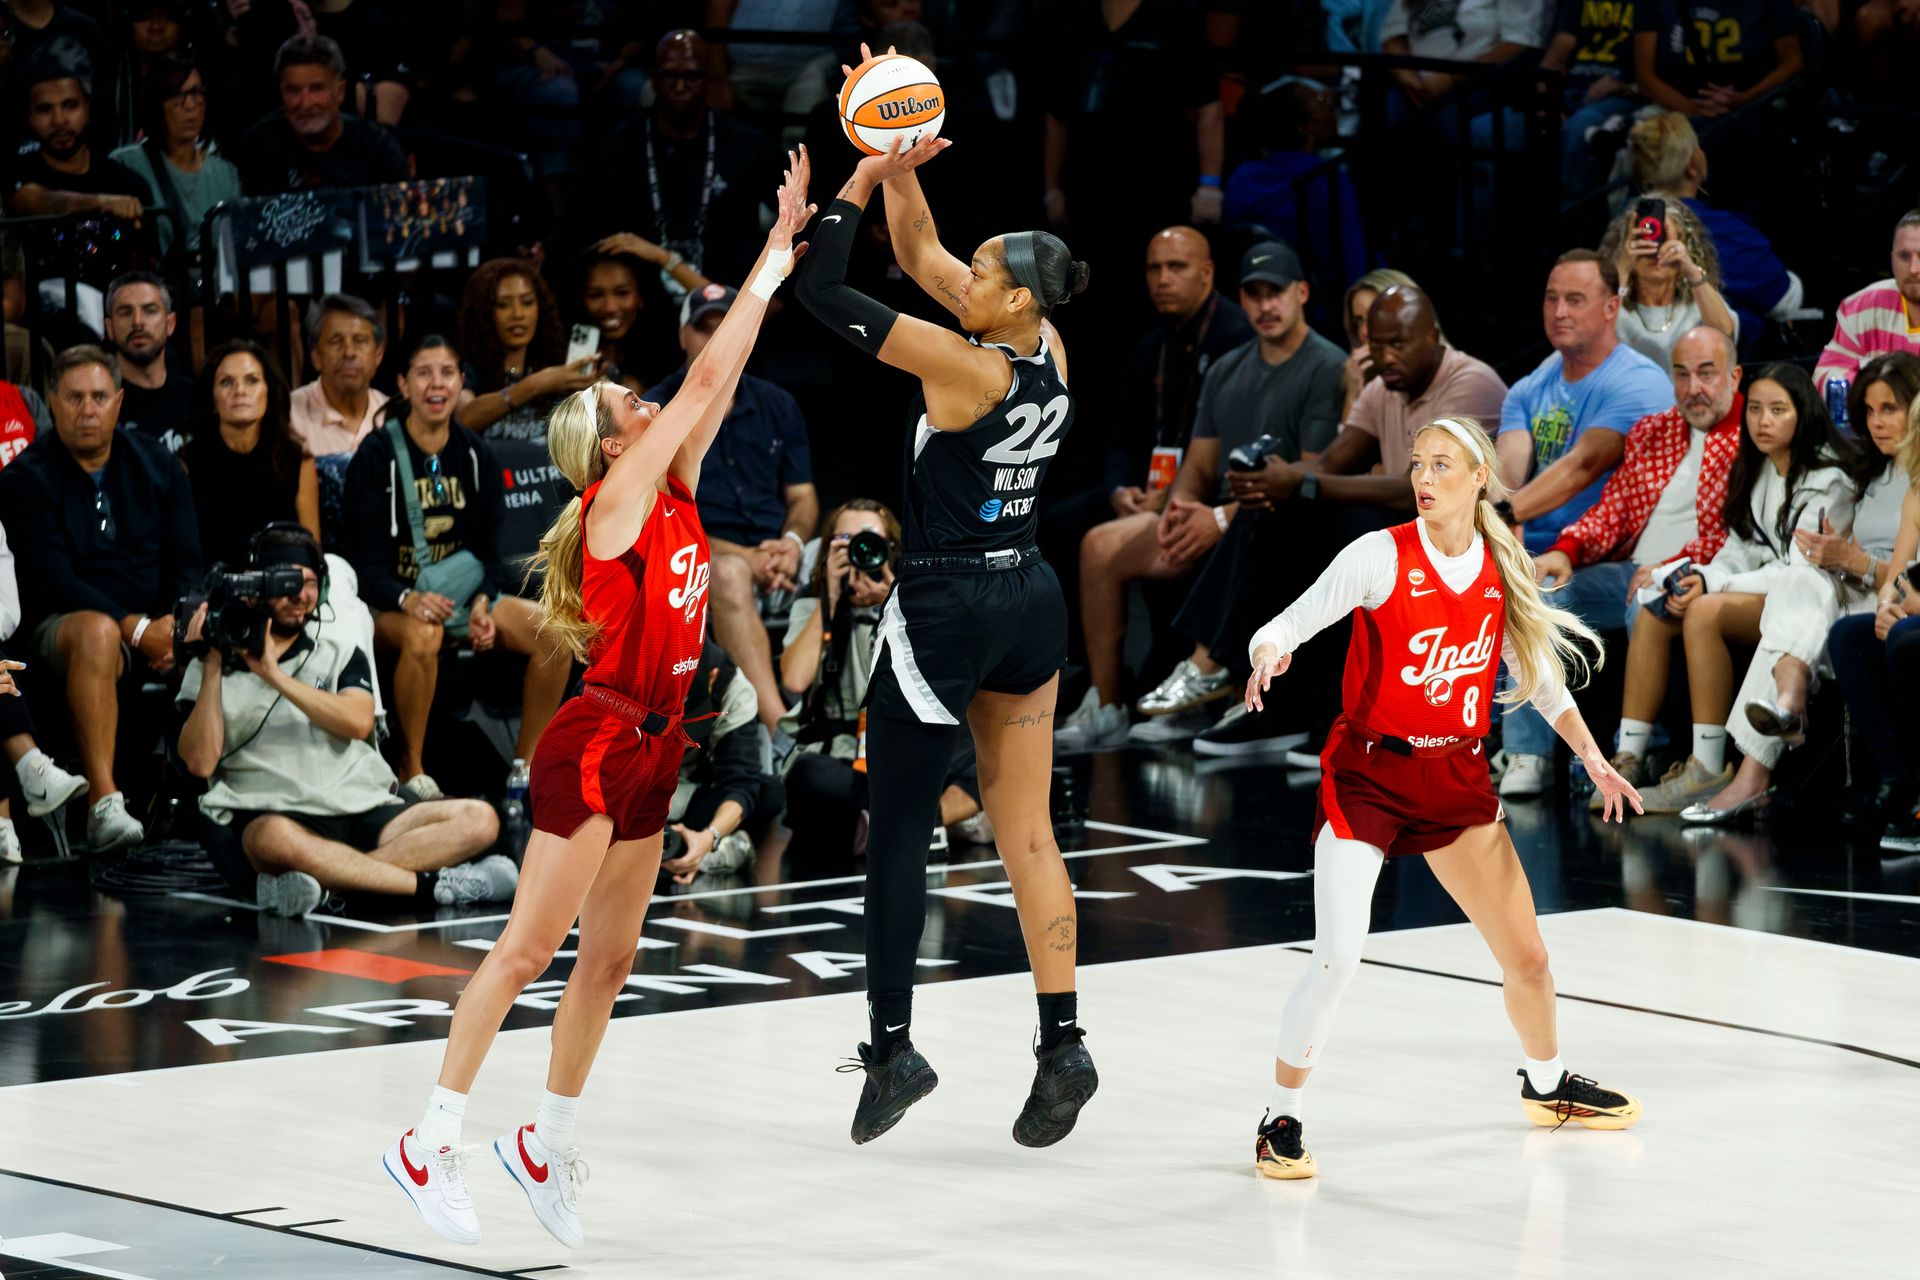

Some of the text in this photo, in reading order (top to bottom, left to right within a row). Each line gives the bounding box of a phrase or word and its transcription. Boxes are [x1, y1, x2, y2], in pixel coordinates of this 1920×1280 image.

[877, 97, 940, 121] Wilson
[982, 395, 1069, 464] 22
[994, 466, 1039, 491] WILSON
[1002, 496, 1036, 517] AT&T
[669, 544, 710, 609] In
[1484, 586, 1503, 601] Lilly
[1400, 613, 1496, 686] Indy
[1462, 685, 1480, 728] 8
